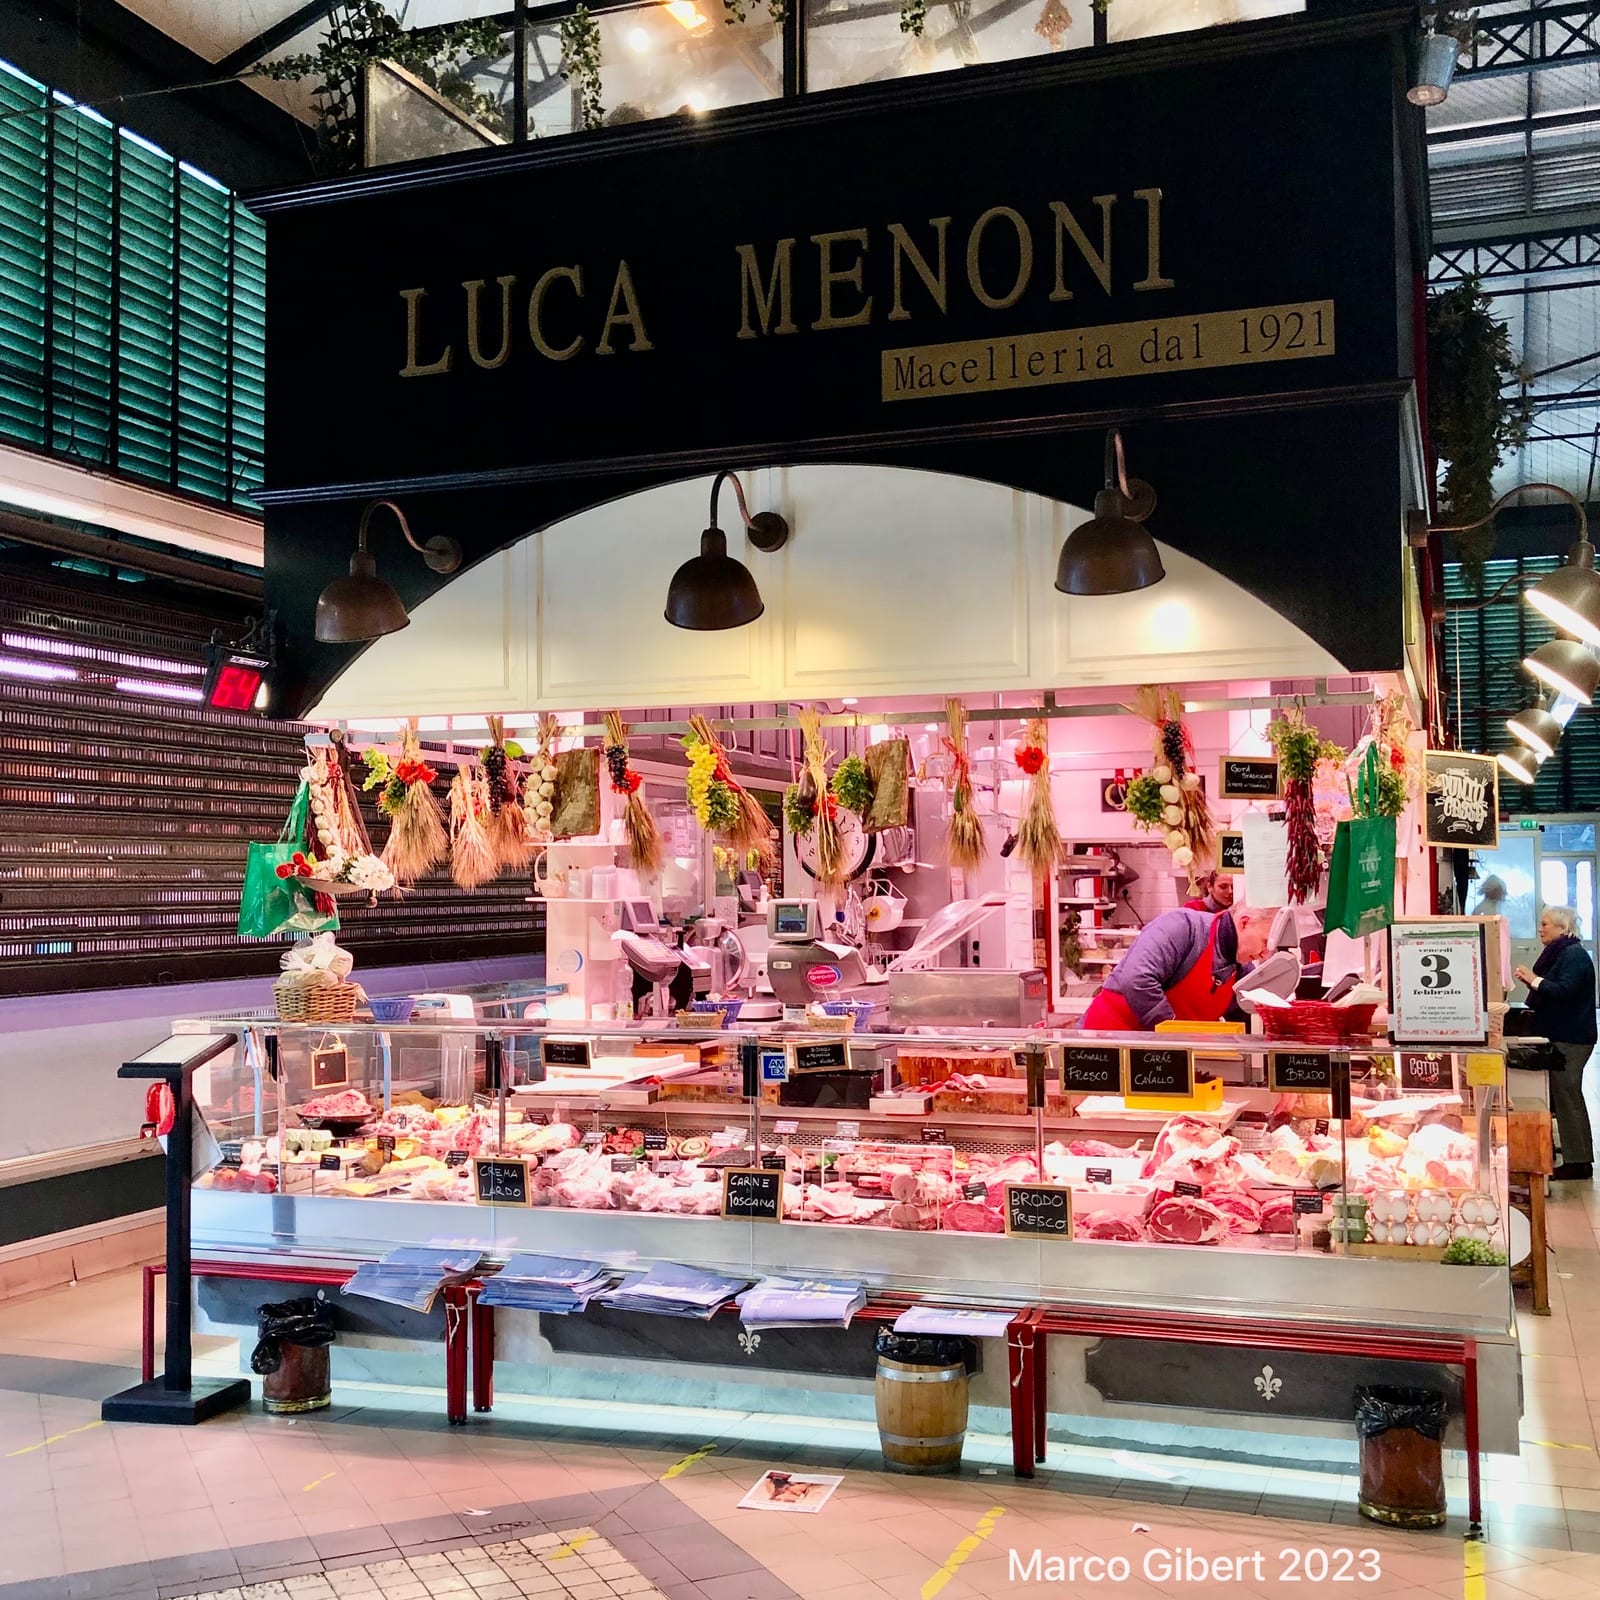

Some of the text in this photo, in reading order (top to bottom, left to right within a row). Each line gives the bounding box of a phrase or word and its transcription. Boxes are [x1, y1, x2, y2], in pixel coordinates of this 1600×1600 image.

[399, 187, 1175, 378] LUCA MENONI
[893, 309, 1328, 392] Macelleria dal 1921
[1420, 953, 1452, 988] 3
[1143, 1051, 1172, 1063] CARNE
[1288, 1055, 1319, 1066] MAIALE
[1067, 1065, 1109, 1082] FRESCO
[1285, 1067, 1326, 1081] BRADO
[1409, 1057, 1440, 1076] COTTO
[1134, 1070, 1175, 1085] CAVALLO
[479, 1164, 519, 1178] CREMA
[730, 1175, 770, 1188] CARNE
[480, 1185, 522, 1197] LARDO
[1011, 1190, 1063, 1207] BRODO
[727, 1190, 775, 1210] TOSCANA
[1011, 1208, 1067, 1230] FRESCO
